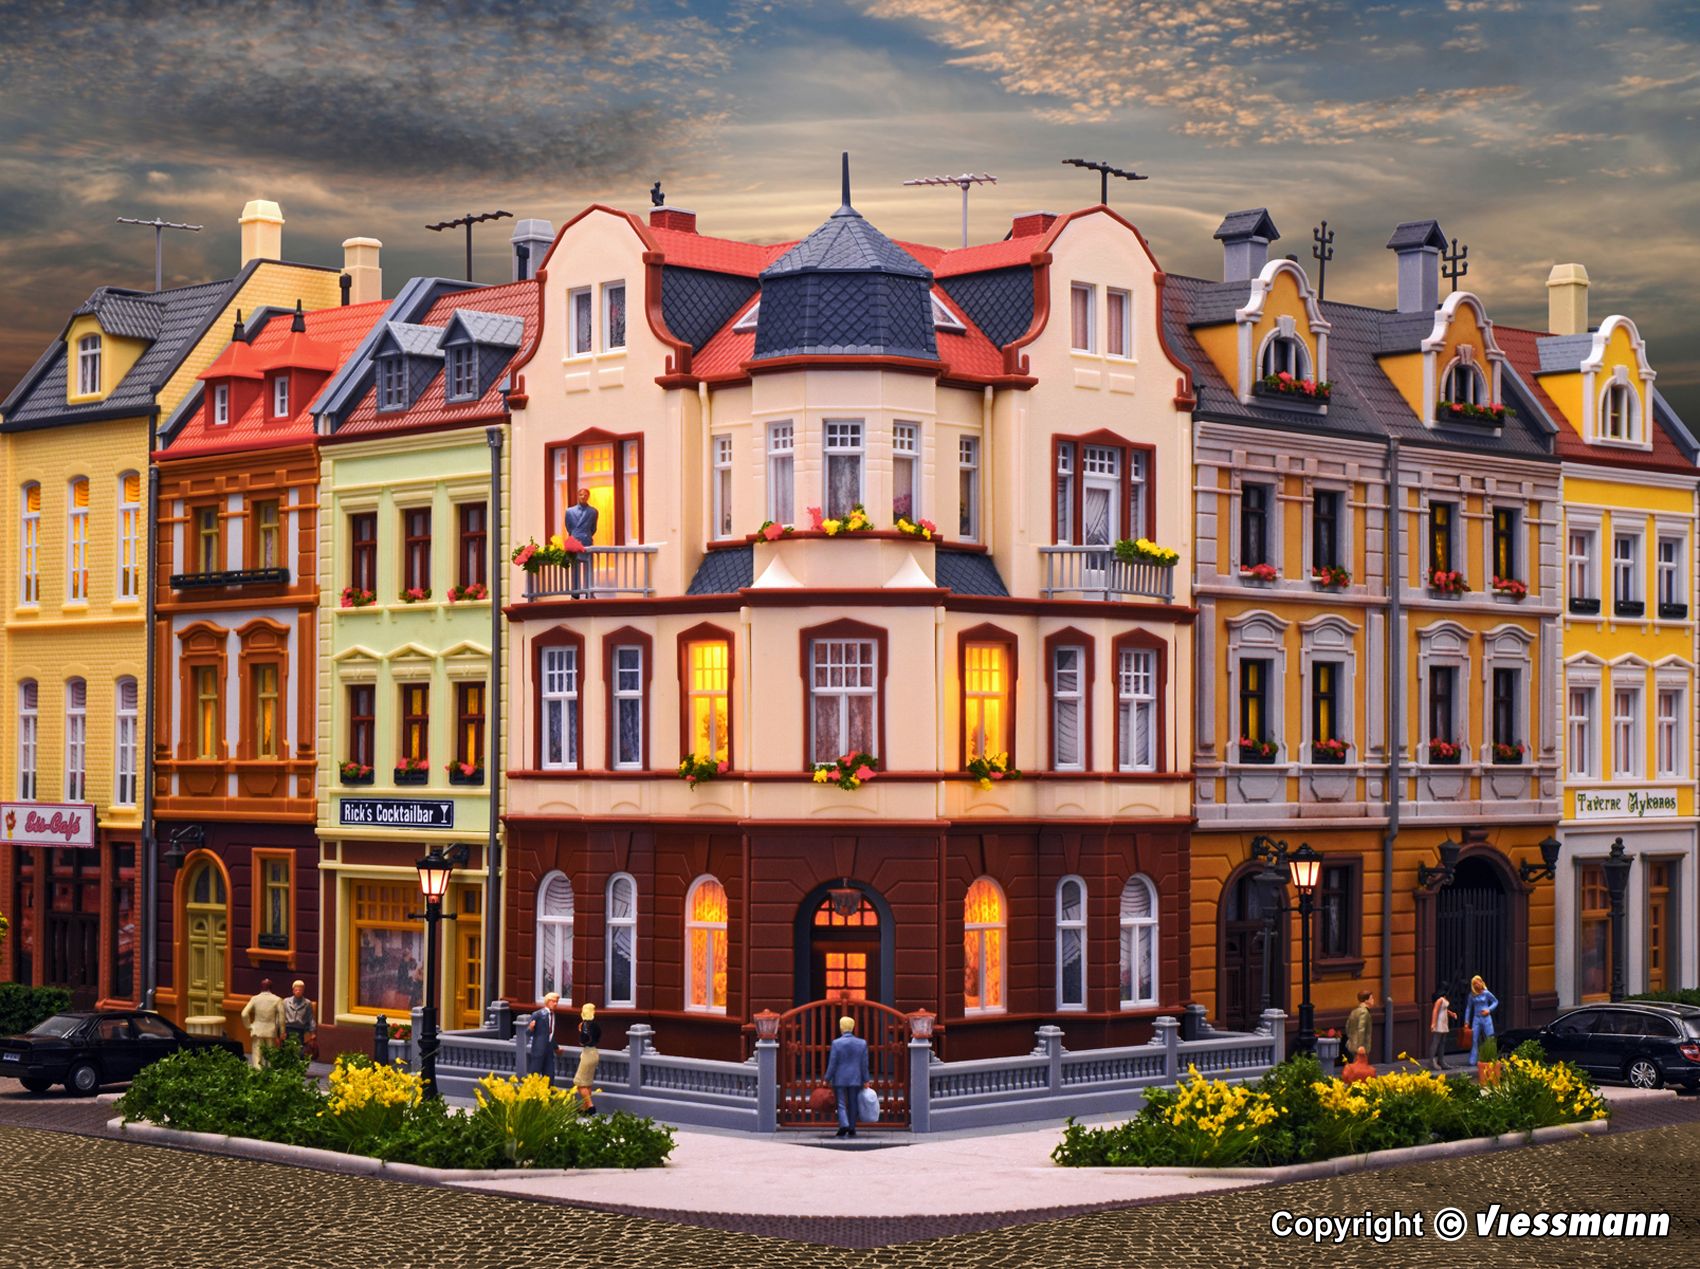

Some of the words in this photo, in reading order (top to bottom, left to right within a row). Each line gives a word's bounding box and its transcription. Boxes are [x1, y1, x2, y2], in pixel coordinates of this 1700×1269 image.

[344, 803, 373, 822] Rick's
[376, 803, 434, 823] Cocktailbar
[1577, 793, 1621, 812] Taverne
[1628, 792, 1676, 817] Mykonos
[25, 810, 81, 841] Eis-Café
